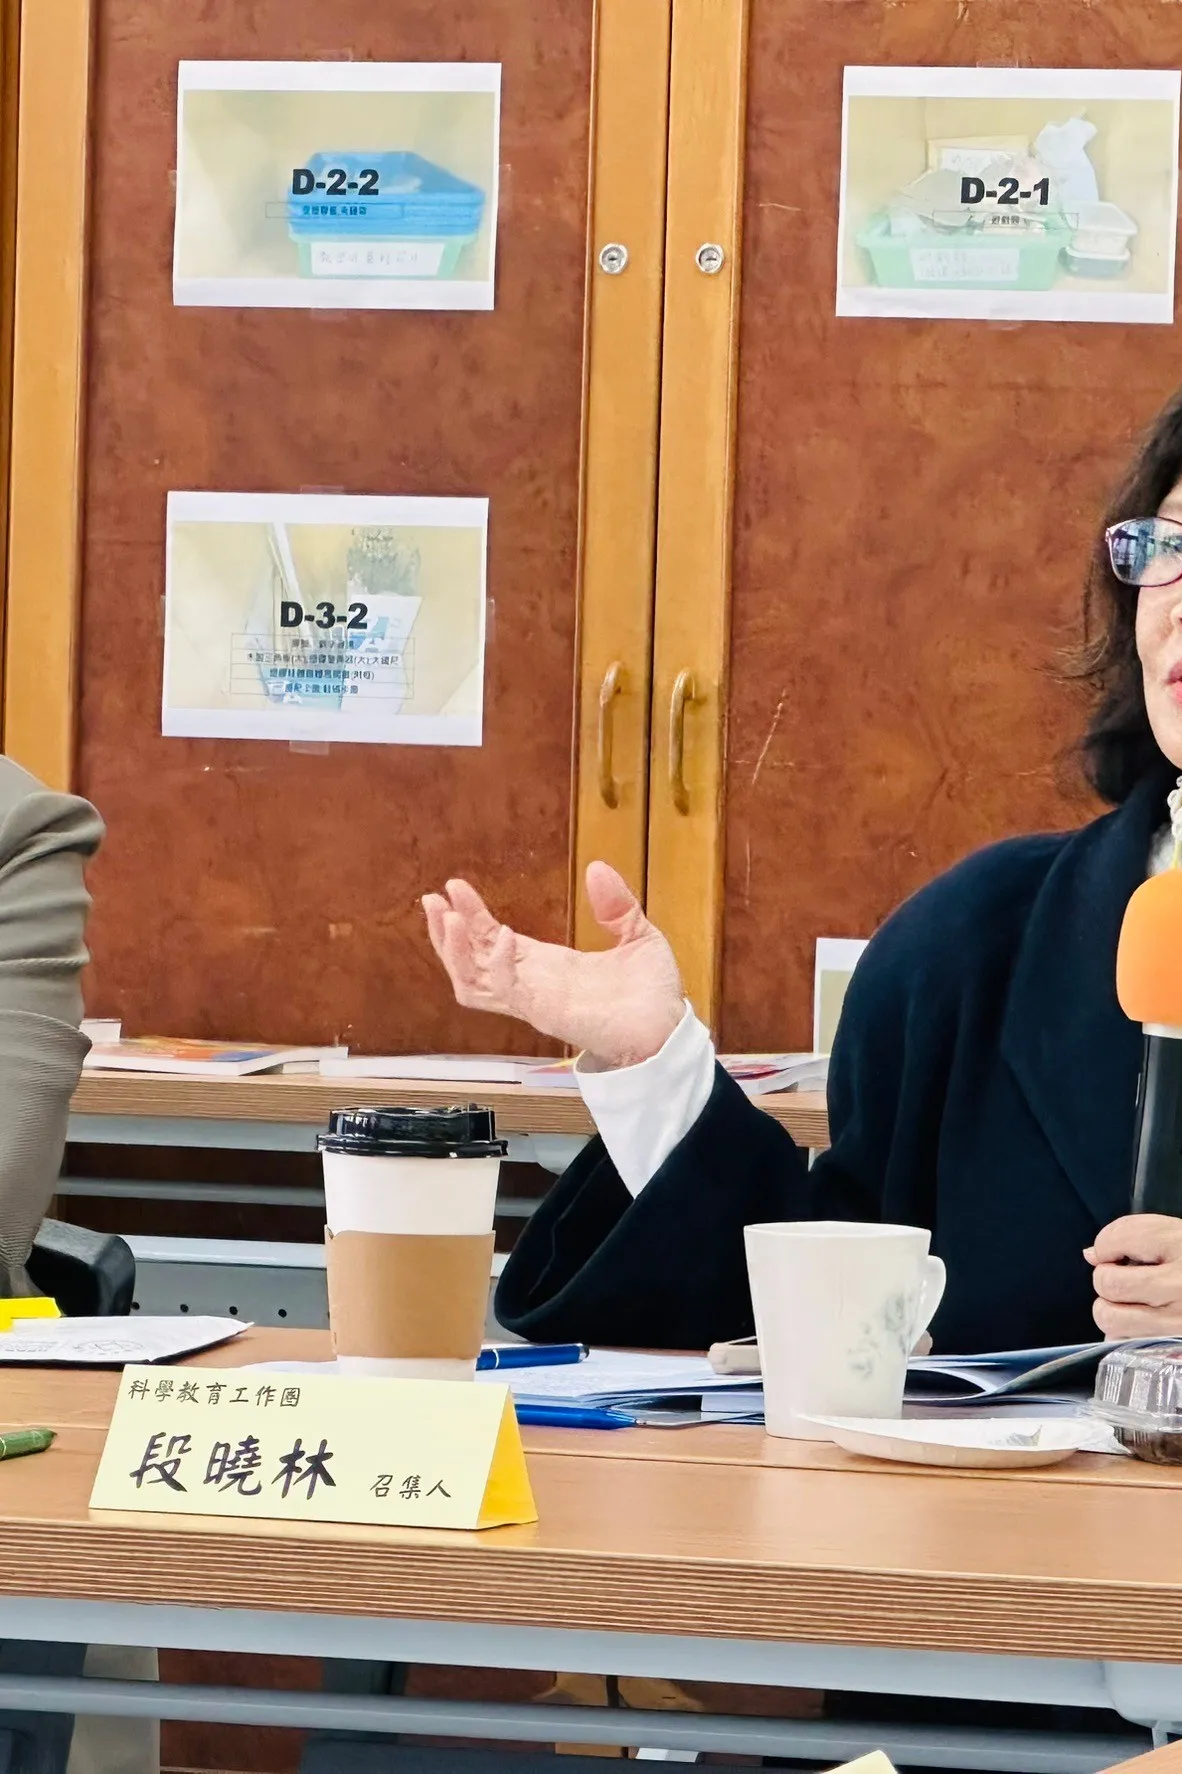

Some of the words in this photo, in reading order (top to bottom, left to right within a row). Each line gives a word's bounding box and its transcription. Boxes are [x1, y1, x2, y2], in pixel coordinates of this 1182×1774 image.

[292, 169, 379, 195] D-2-2
[960, 177, 1050, 205] D-2-1
[280, 601, 368, 629] D-3-2
[128, 1379, 300, 1407] 科學教育工作圈
[129, 1432, 336, 1500] 段曉林
[369, 1474, 452, 1500] 召集人
